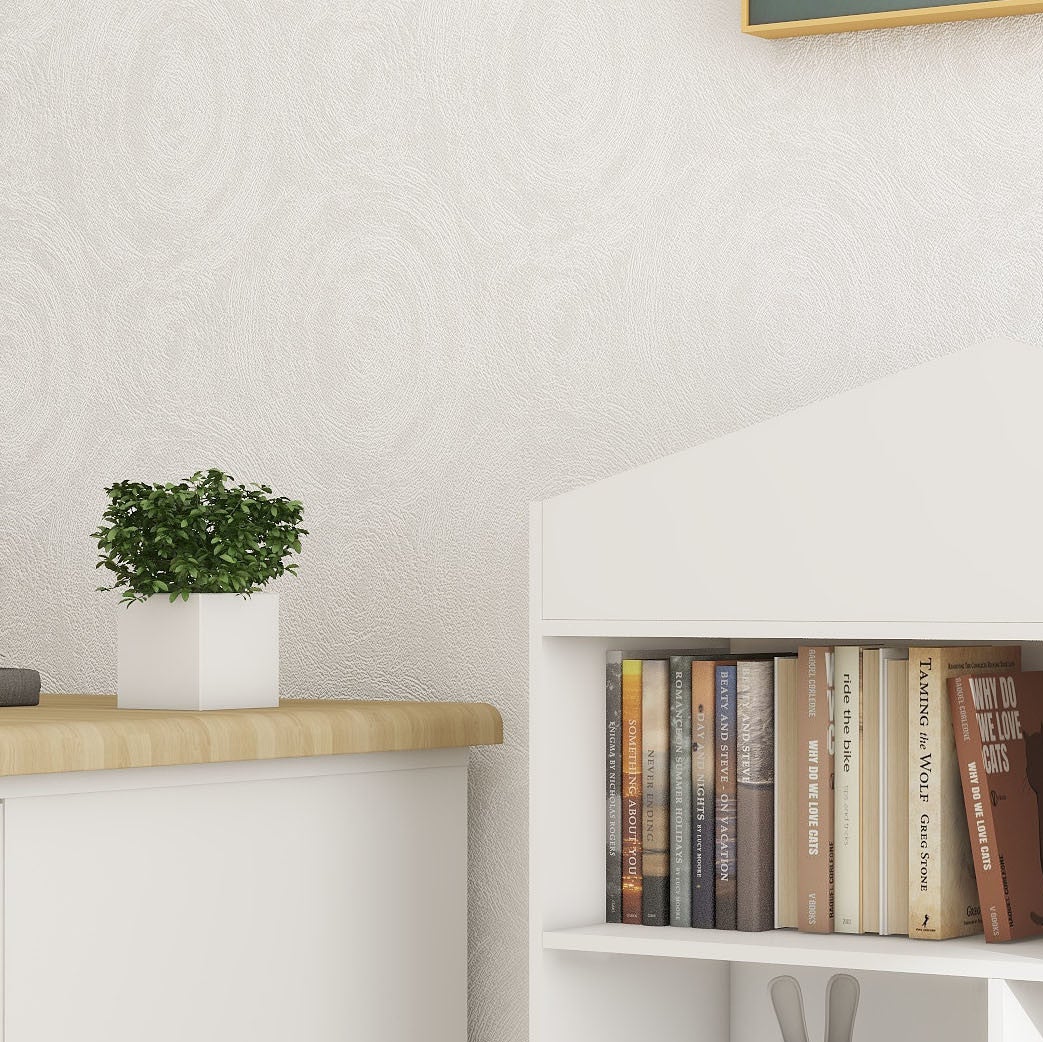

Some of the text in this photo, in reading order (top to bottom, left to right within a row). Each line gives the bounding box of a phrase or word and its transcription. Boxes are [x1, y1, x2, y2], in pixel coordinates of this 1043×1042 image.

[720, 671, 729, 710] BEATY
[969, 676, 1017, 710] WHY DO
[720, 713, 729, 741] AND
[843, 673, 852, 773] ride the bike
[919, 657, 932, 803] TAMING the WOLF
[976, 710, 1023, 742] WE LOVE
[628, 719, 638, 797] SOMETHING
[720, 744, 729, 783] STEVE
[982, 743, 1010, 774] CATS
[608, 721, 617, 857] ENIGMA BY NICHOLAS ROGERS
[647, 749, 655, 842] NEVER ENDING
[720, 793, 729, 812] ON
[808, 739, 819, 856] WHY DO WE LOVE CATS
[967, 761, 992, 871] WHY DO WE LOVE CATS
[628, 799, 638, 845] ABOUT
[674, 807, 683, 864] HOLIDAYS
[720, 816, 729, 882] VACATION
[920, 813, 930, 892] GREG STONE
